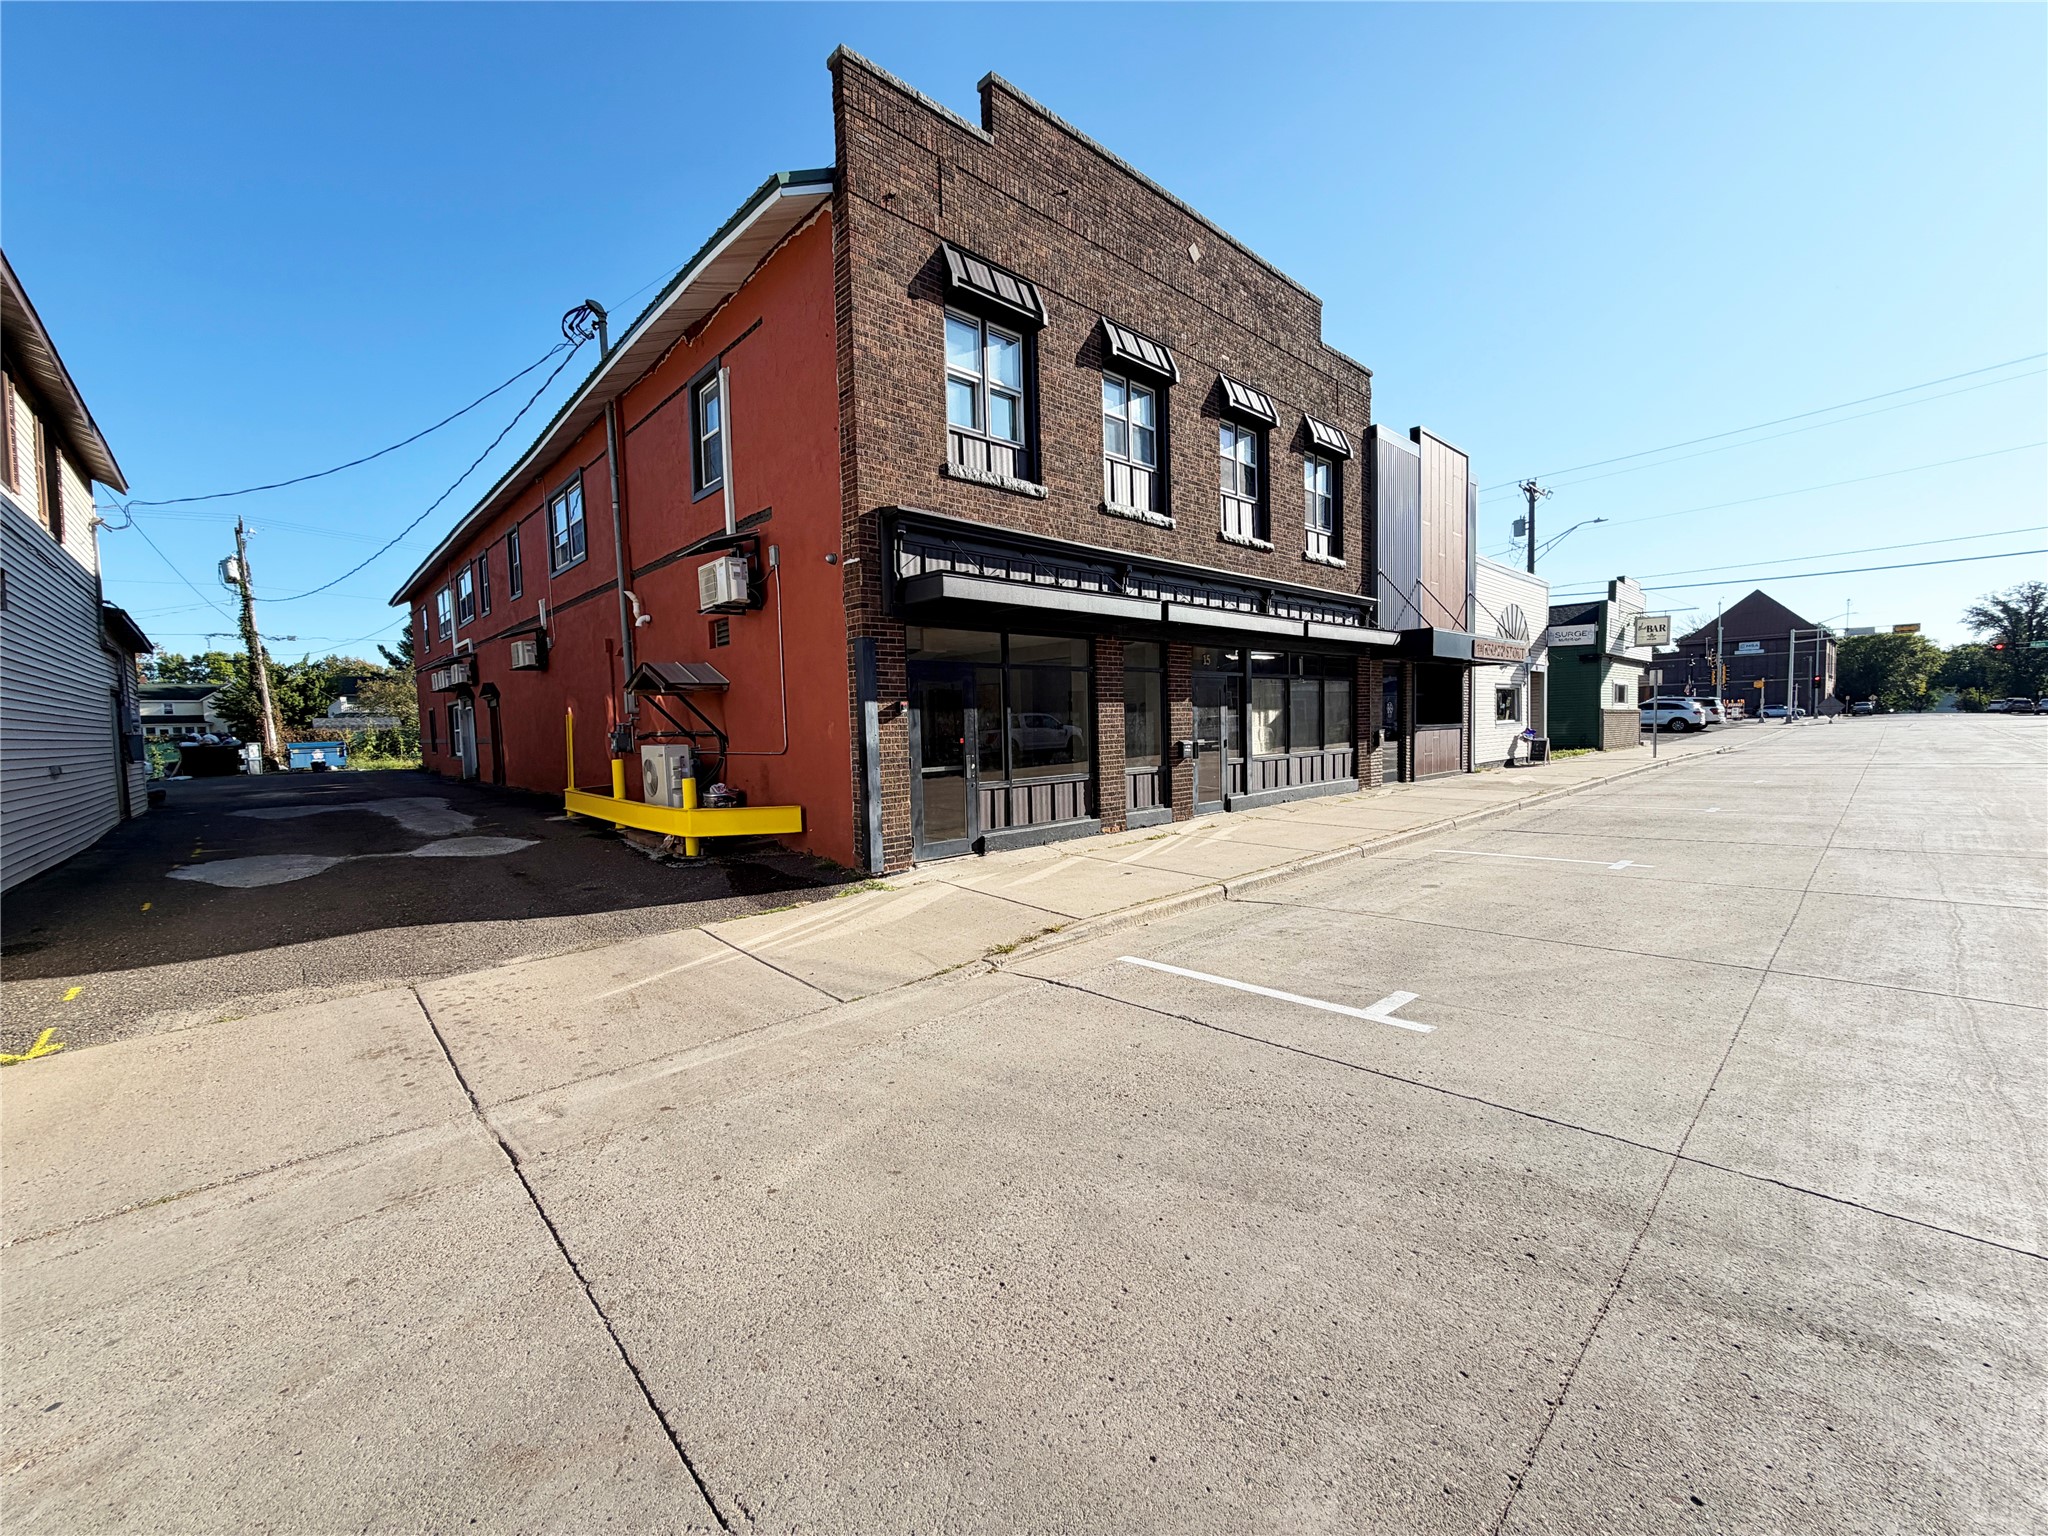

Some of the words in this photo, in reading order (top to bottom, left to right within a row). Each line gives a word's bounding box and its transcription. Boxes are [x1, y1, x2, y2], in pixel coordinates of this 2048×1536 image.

[1646, 624, 1666, 633] BAR
[1555, 630, 1587, 639] SURGE
[1203, 655, 1211, 666] 15
